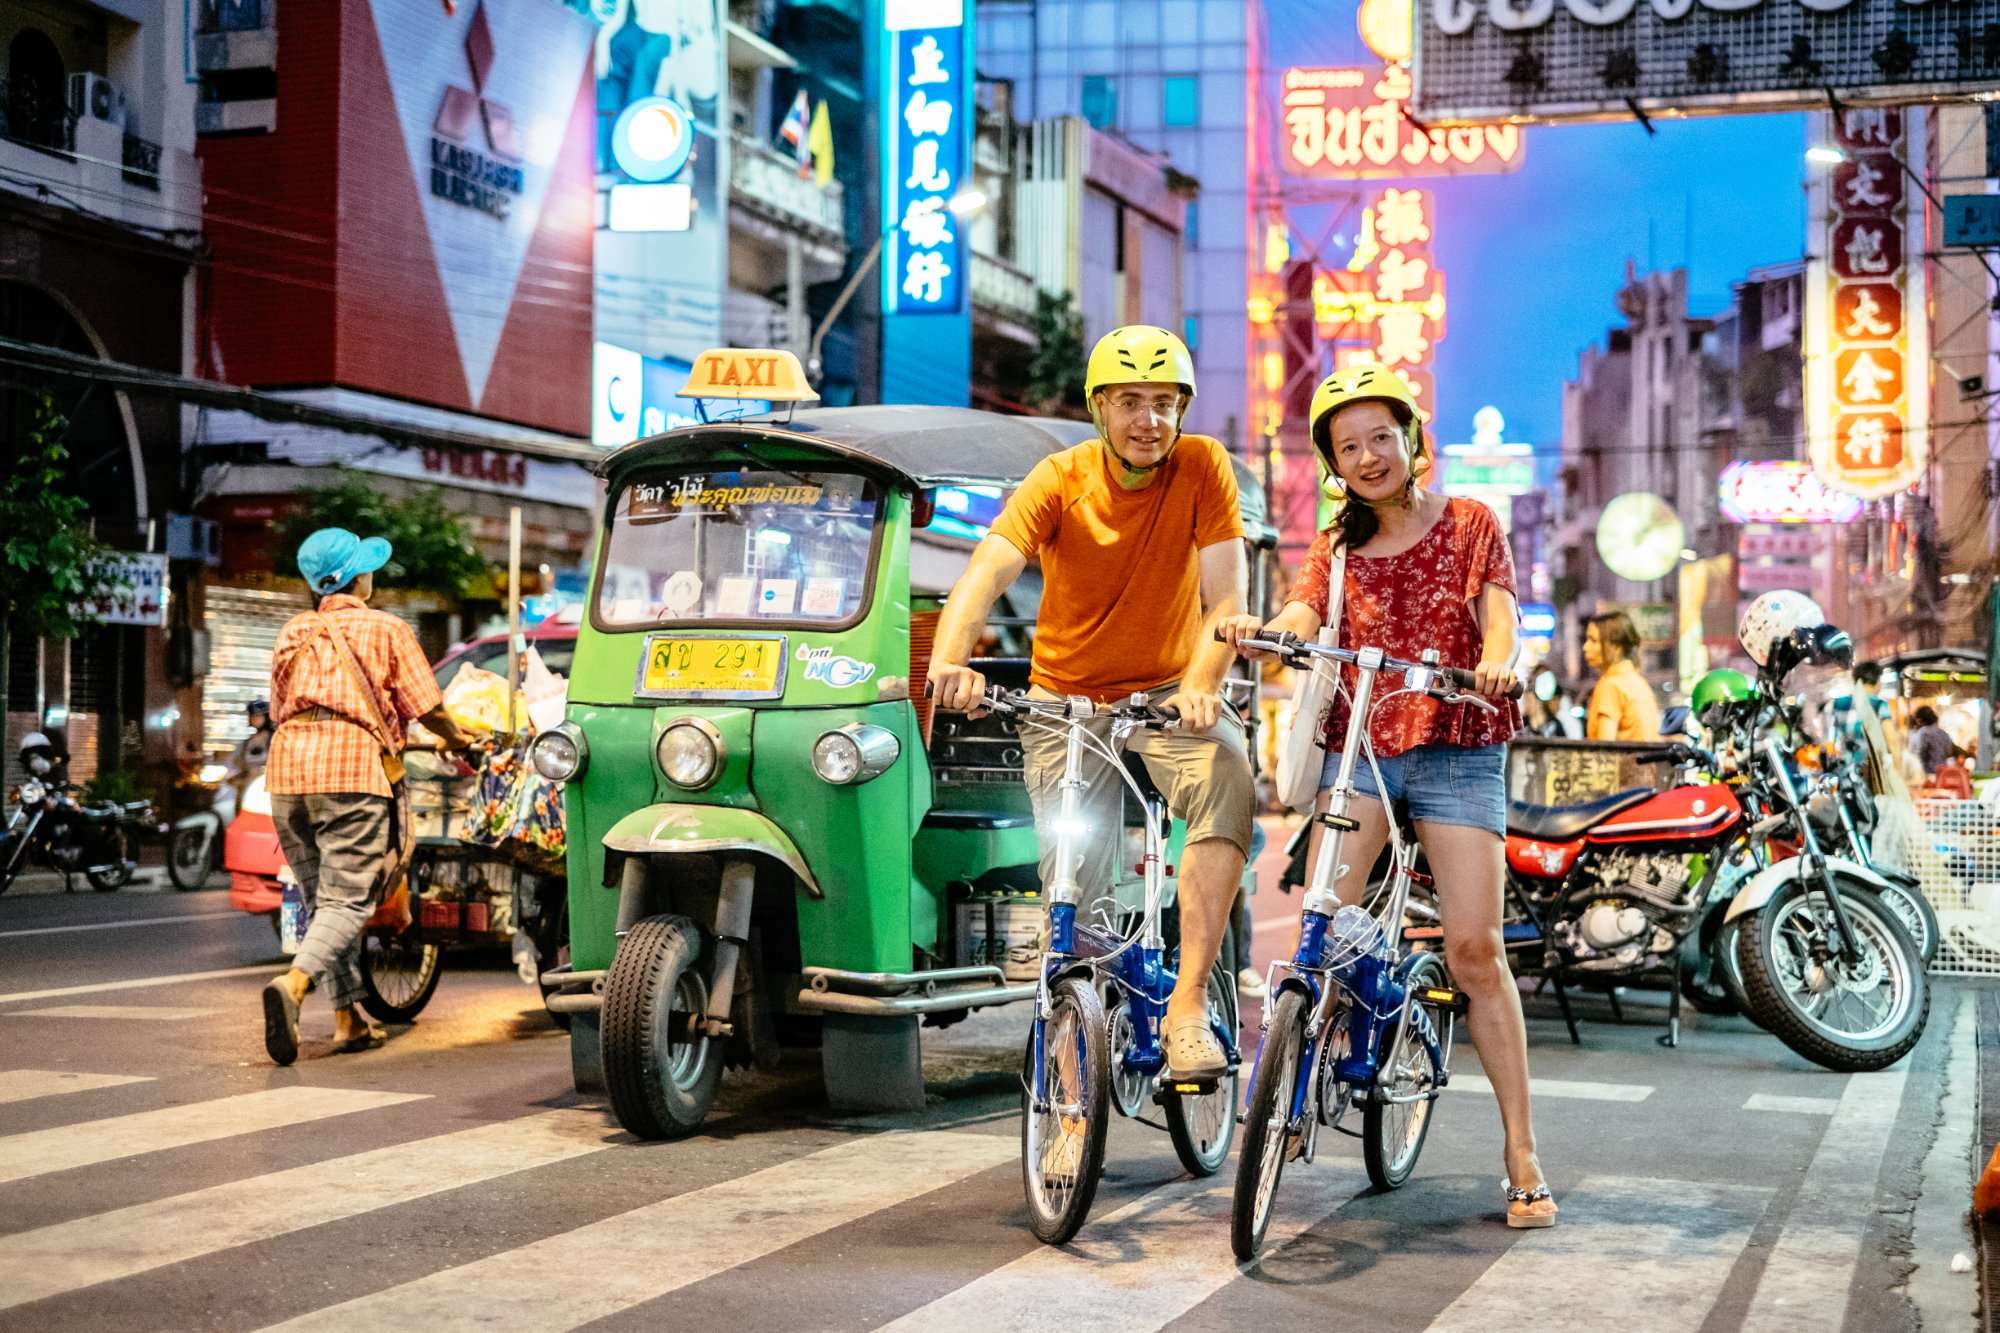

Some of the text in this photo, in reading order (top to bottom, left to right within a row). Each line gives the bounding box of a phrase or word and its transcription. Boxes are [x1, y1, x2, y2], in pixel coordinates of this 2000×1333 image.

[705, 357, 778, 386] TAXI
[714, 643, 763, 669] 291
[809, 649, 830, 659] ptt
[807, 659, 874, 685] NGV
